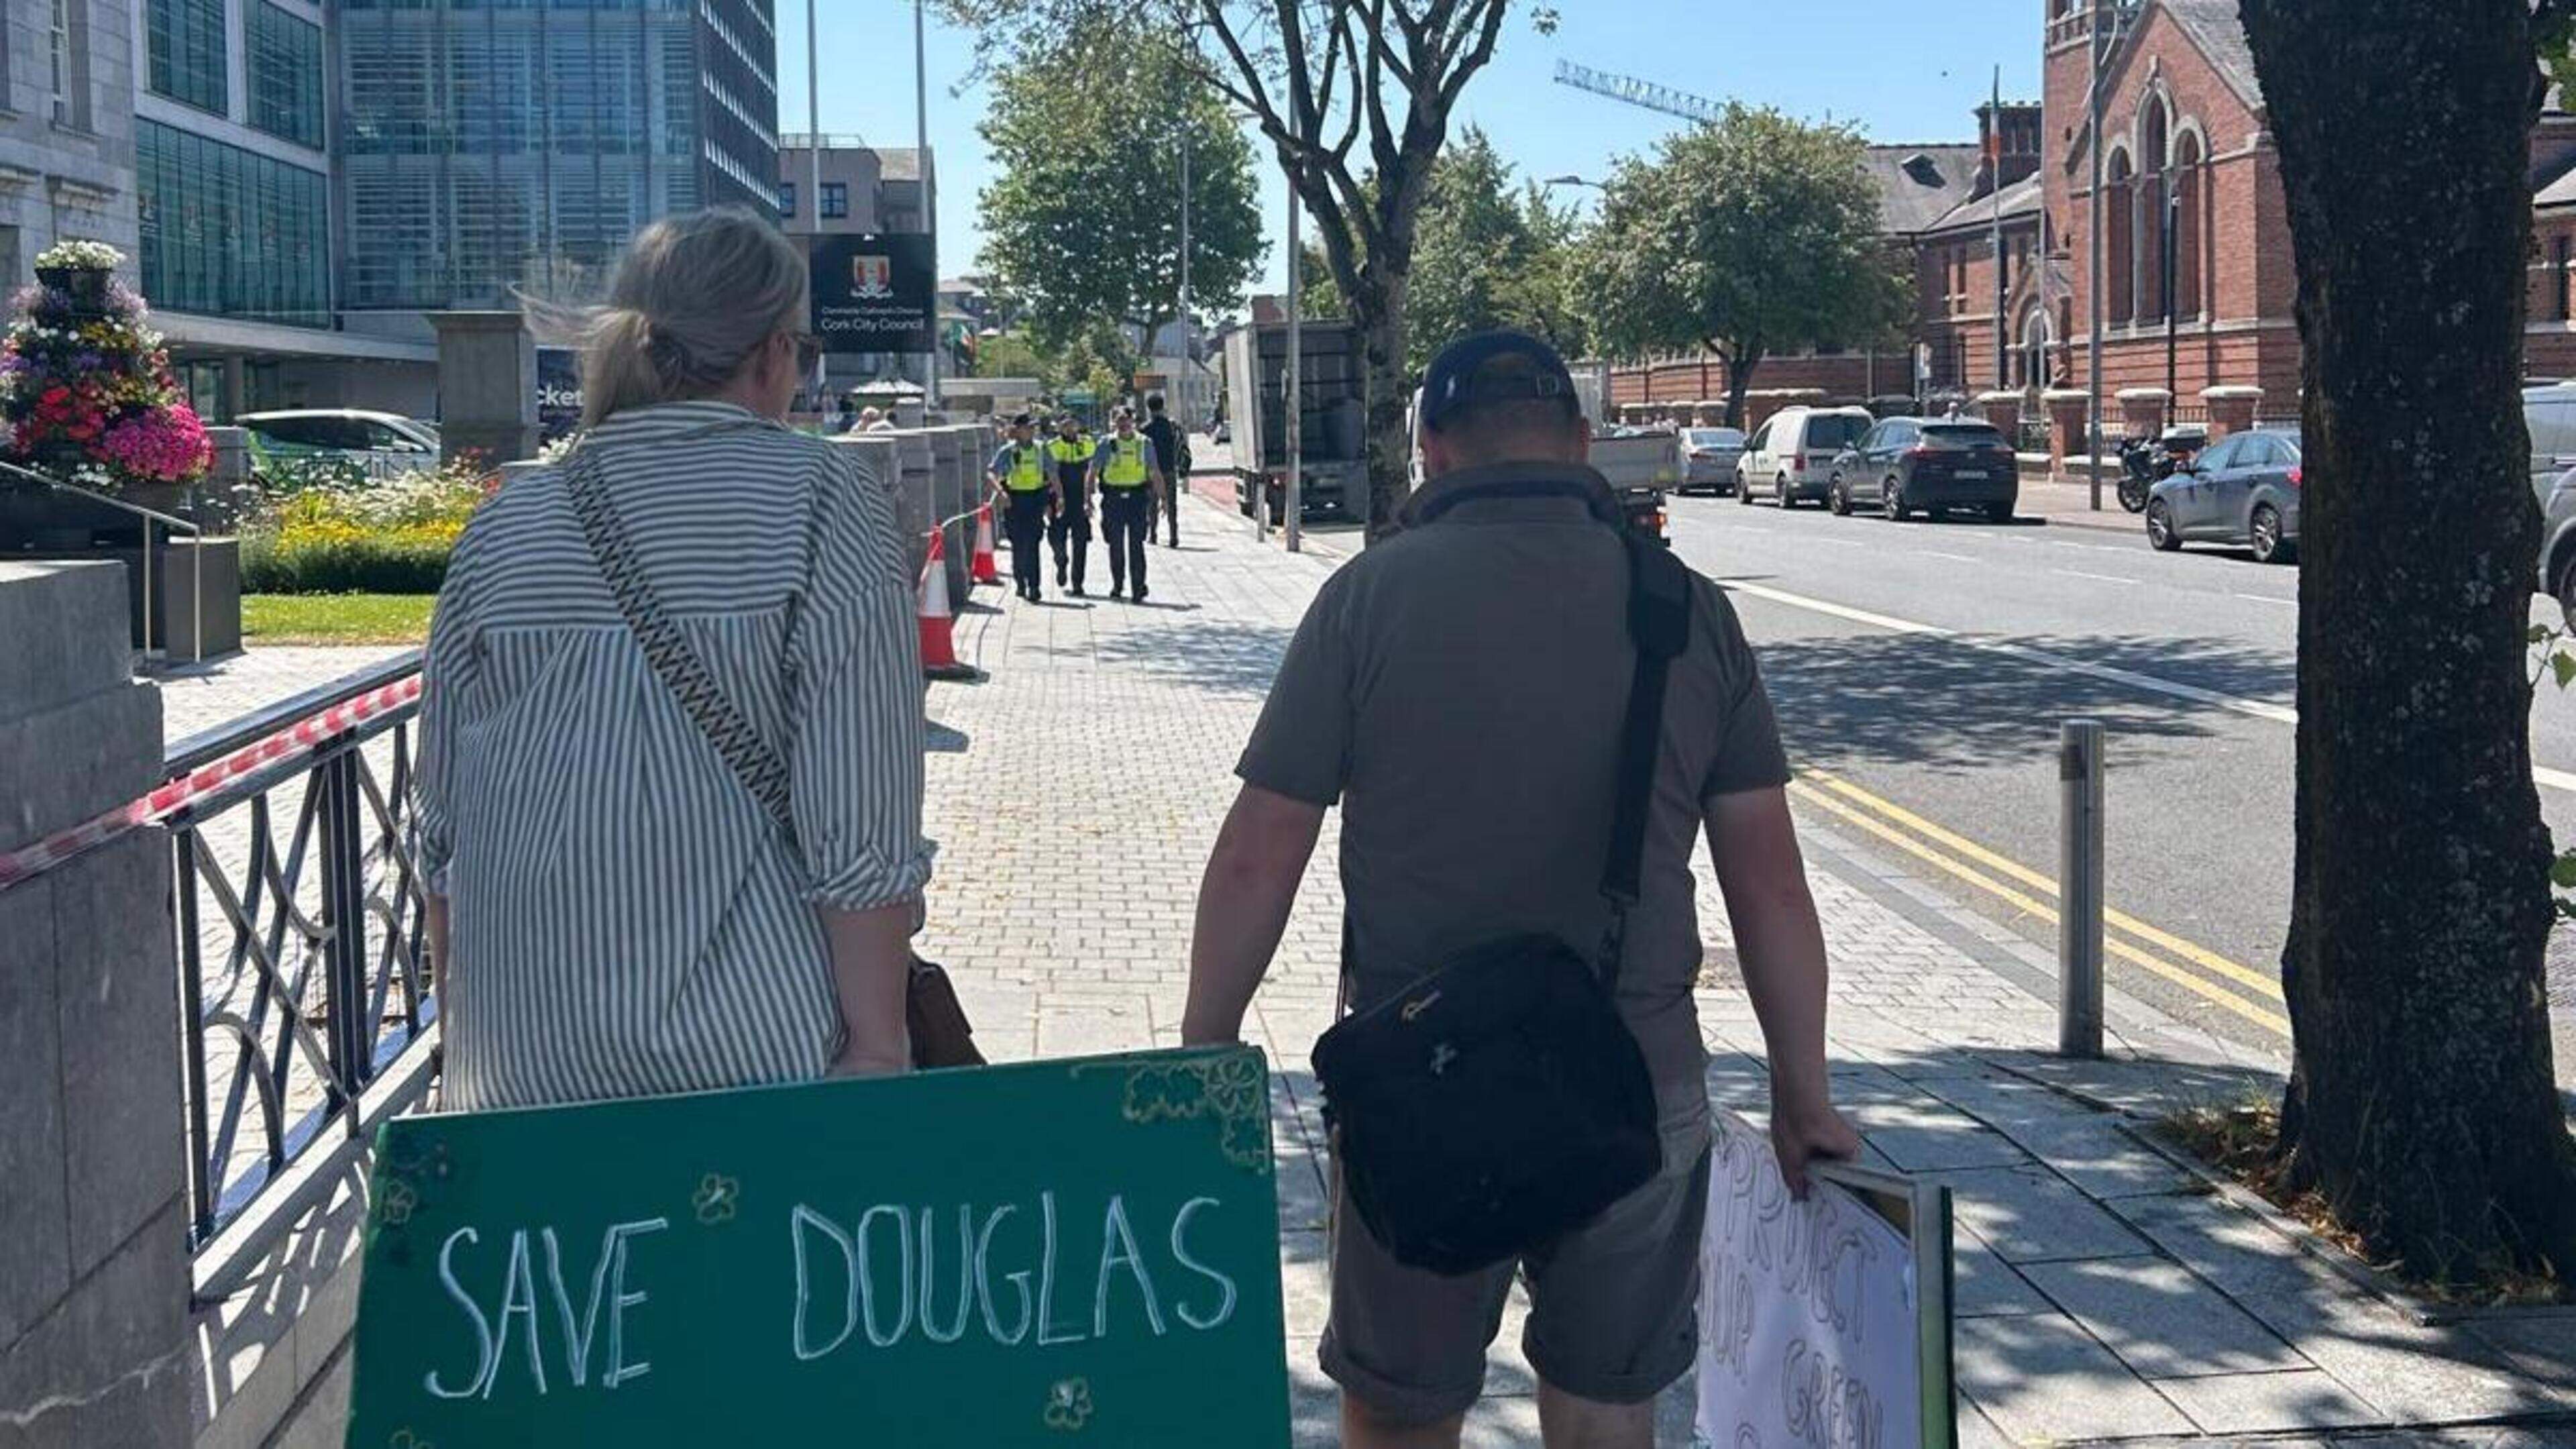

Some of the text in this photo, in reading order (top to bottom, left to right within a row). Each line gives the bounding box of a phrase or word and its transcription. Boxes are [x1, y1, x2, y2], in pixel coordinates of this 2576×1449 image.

[822, 317, 924, 333] Cork City Council
[424, 1191, 1238, 1399] SAVE DOUGLAS
